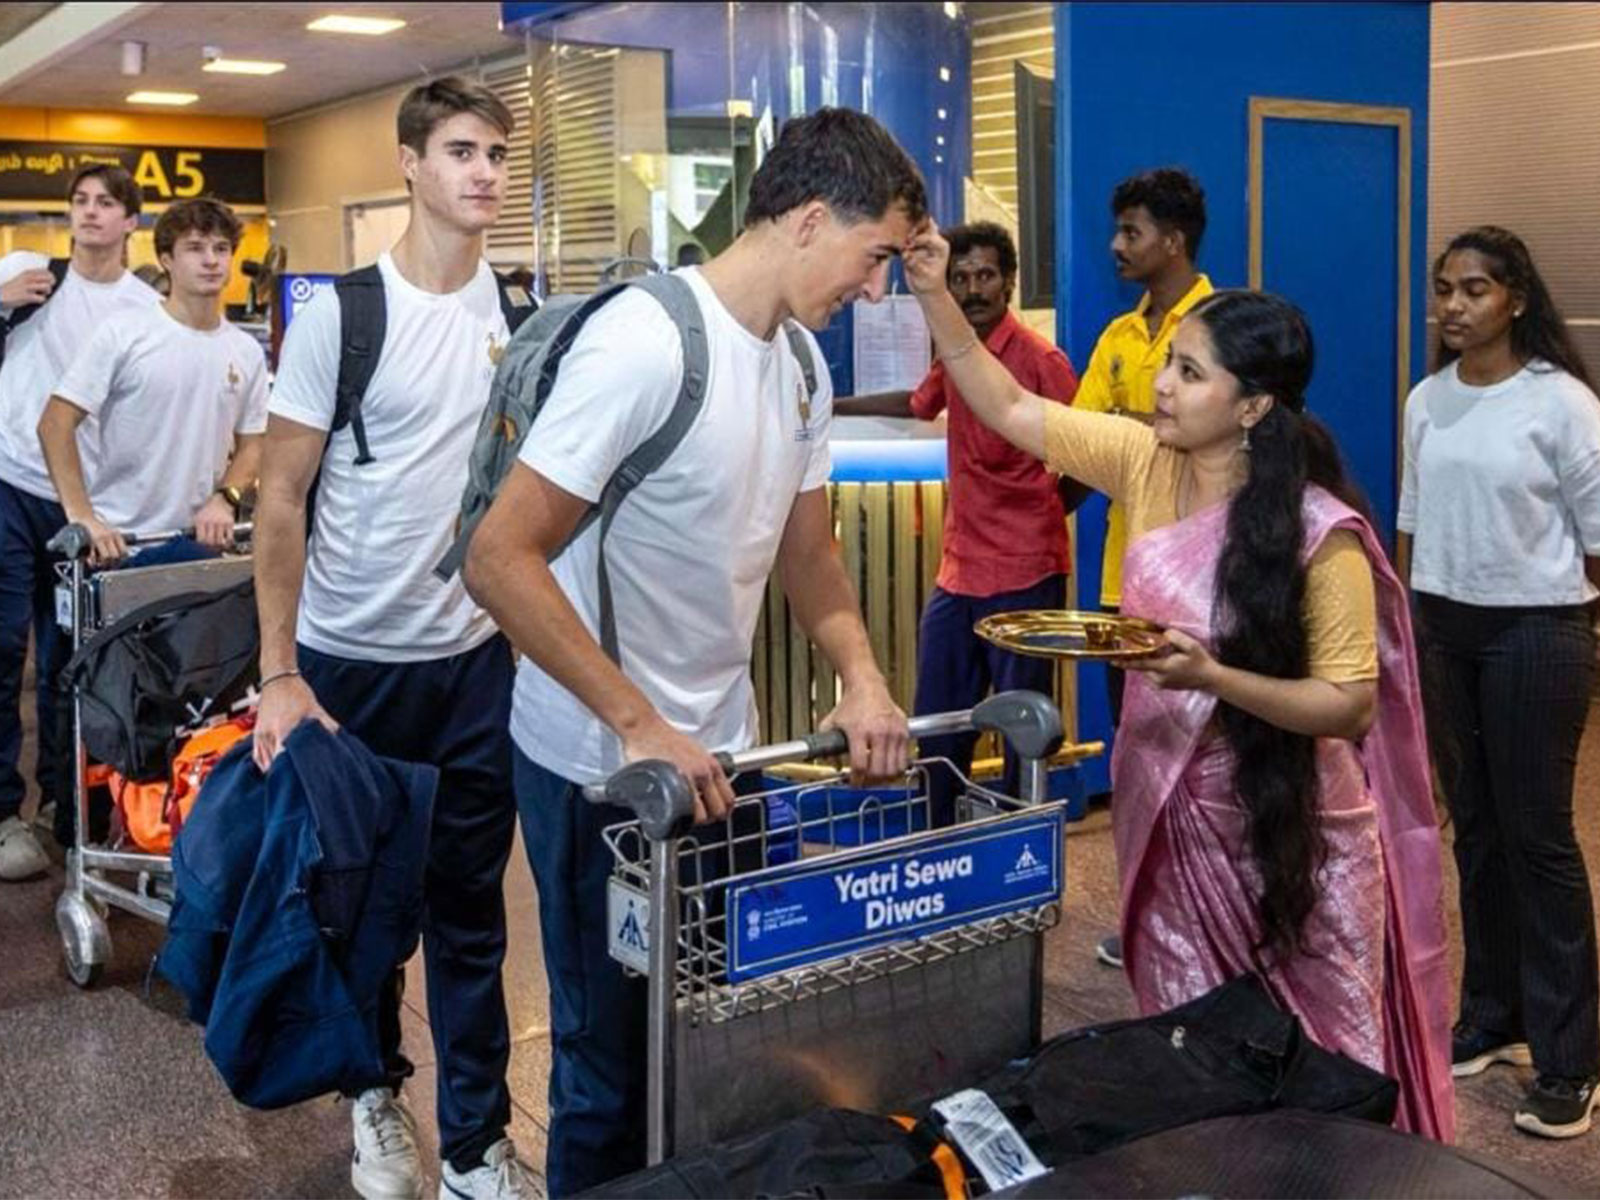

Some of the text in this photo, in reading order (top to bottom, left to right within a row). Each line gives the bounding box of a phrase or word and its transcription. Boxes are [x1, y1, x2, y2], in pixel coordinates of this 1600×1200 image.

[134, 150, 205, 197] A5
[834, 862, 898, 904] Yatri
[904, 854, 973, 889] Sewa
[865, 892, 945, 930] Diwas
